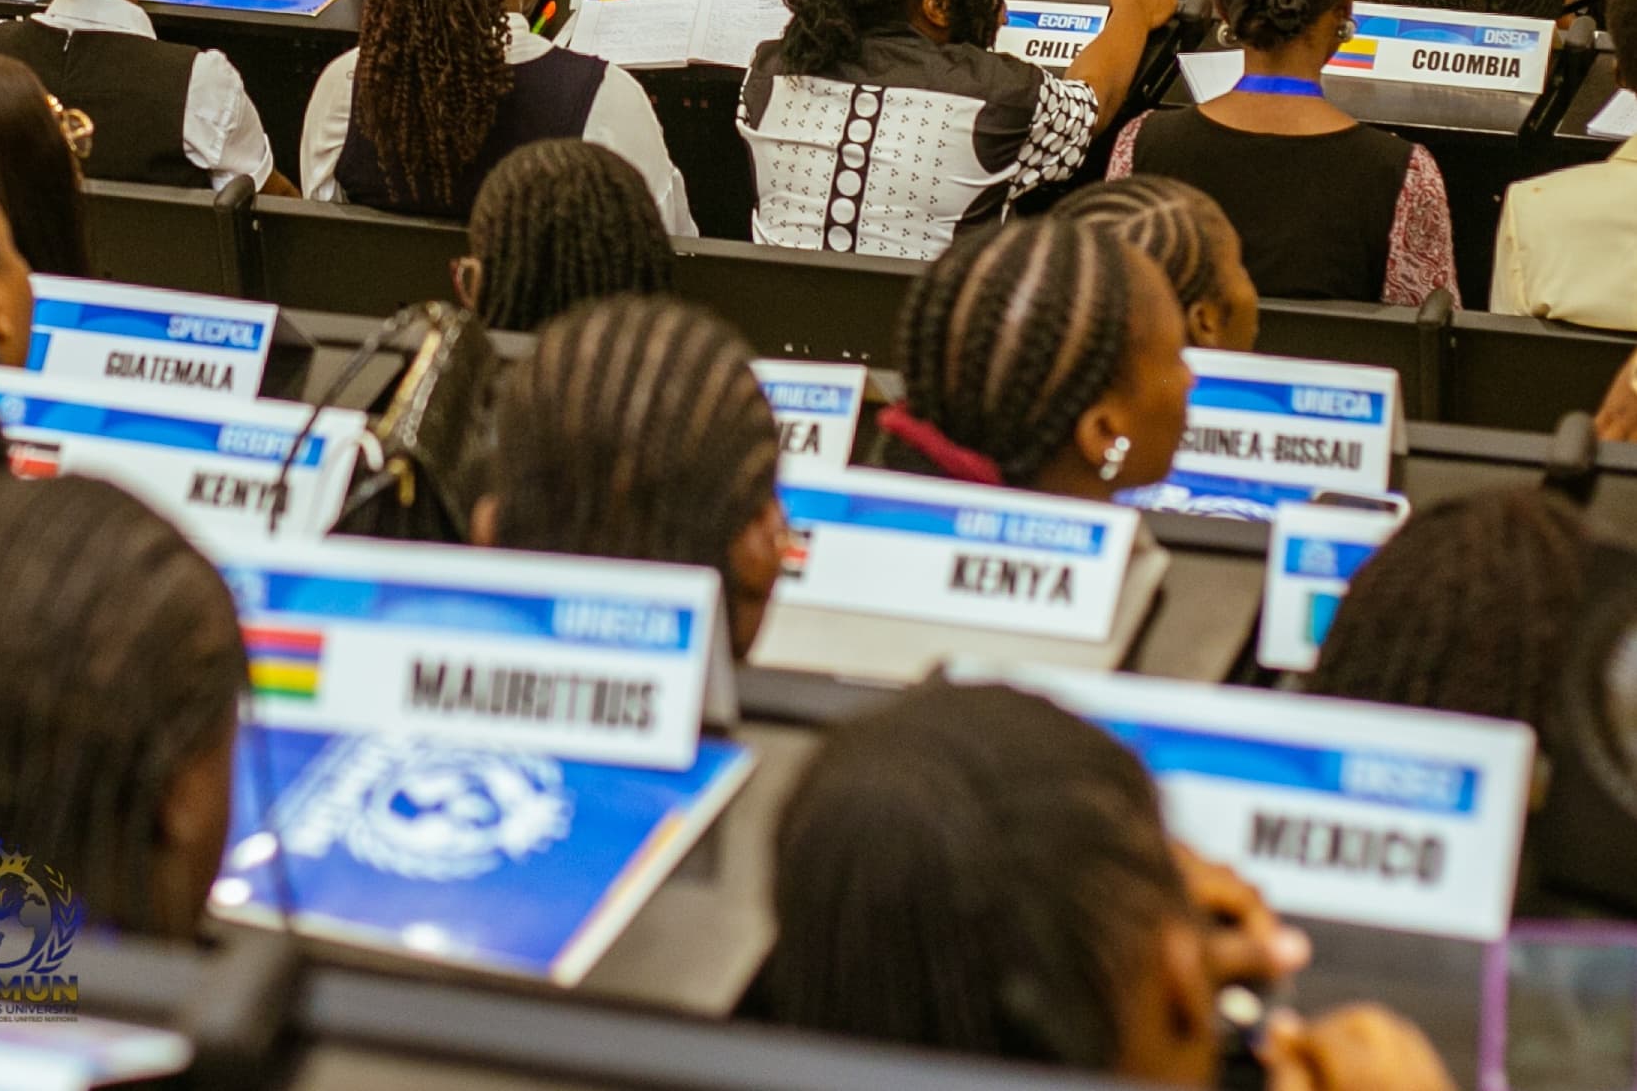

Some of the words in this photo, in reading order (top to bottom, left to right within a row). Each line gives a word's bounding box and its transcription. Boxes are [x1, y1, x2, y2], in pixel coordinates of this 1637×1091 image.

[1037, 13, 1091, 30] ECOFIN
[1483, 28, 1530, 45] DISEC
[1025, 39, 1083, 59] CHILE
[1412, 48, 1521, 78] COLOMBIA
[165, 313, 257, 348] SPECPOL
[103, 349, 235, 392] GUATEMALA
[1291, 384, 1372, 419] UNECA
[950, 552, 1074, 603] KENYA
[408, 658, 656, 730] MAURITIUS
[1249, 811, 1445, 887] MEXICO
